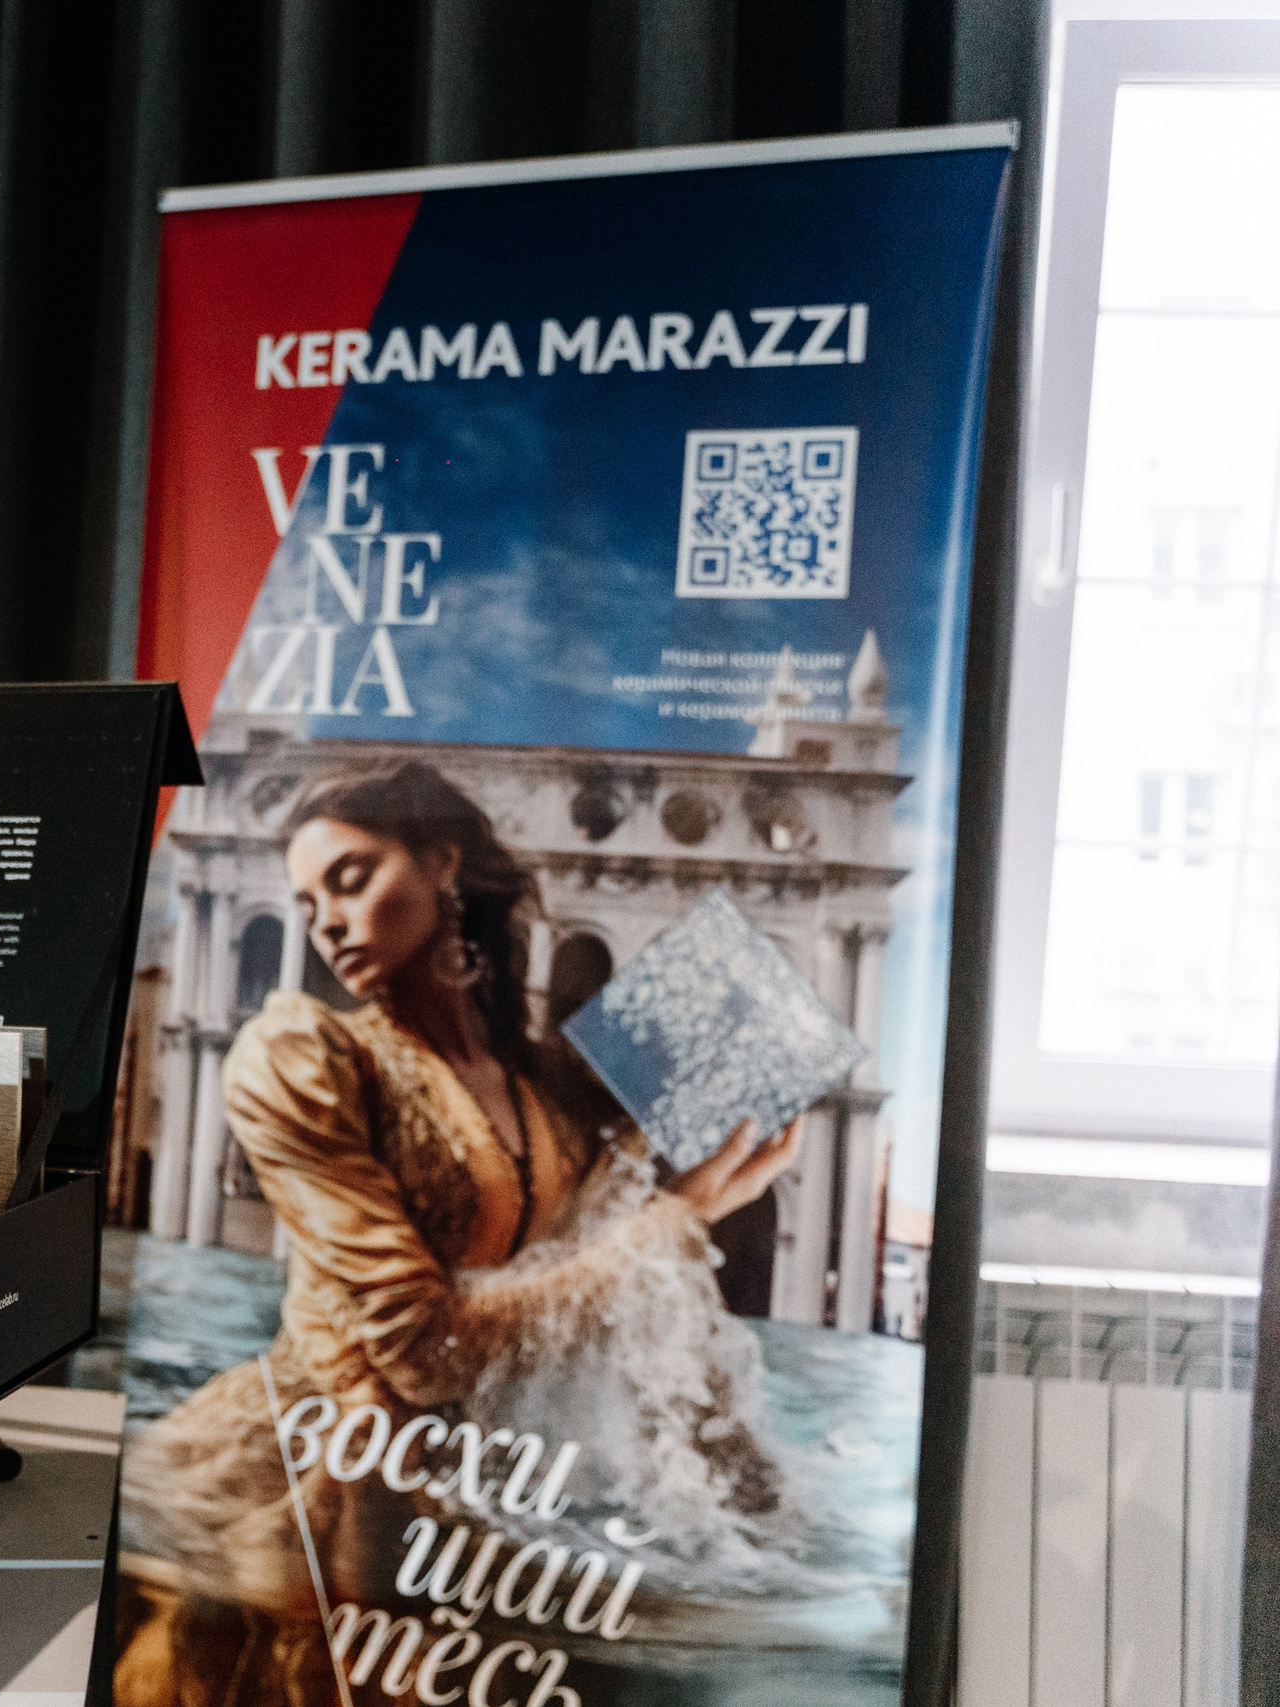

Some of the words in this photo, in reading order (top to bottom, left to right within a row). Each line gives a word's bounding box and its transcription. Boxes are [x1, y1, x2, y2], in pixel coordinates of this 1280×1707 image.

[255, 321, 523, 390] KERAMA
[537, 302, 870, 377] MARAZZI
[251, 443, 386, 538] VE
[300, 533, 443, 627] NE
[244, 624, 416, 718] ZIA
[281, 1394, 582, 1521] восхи
